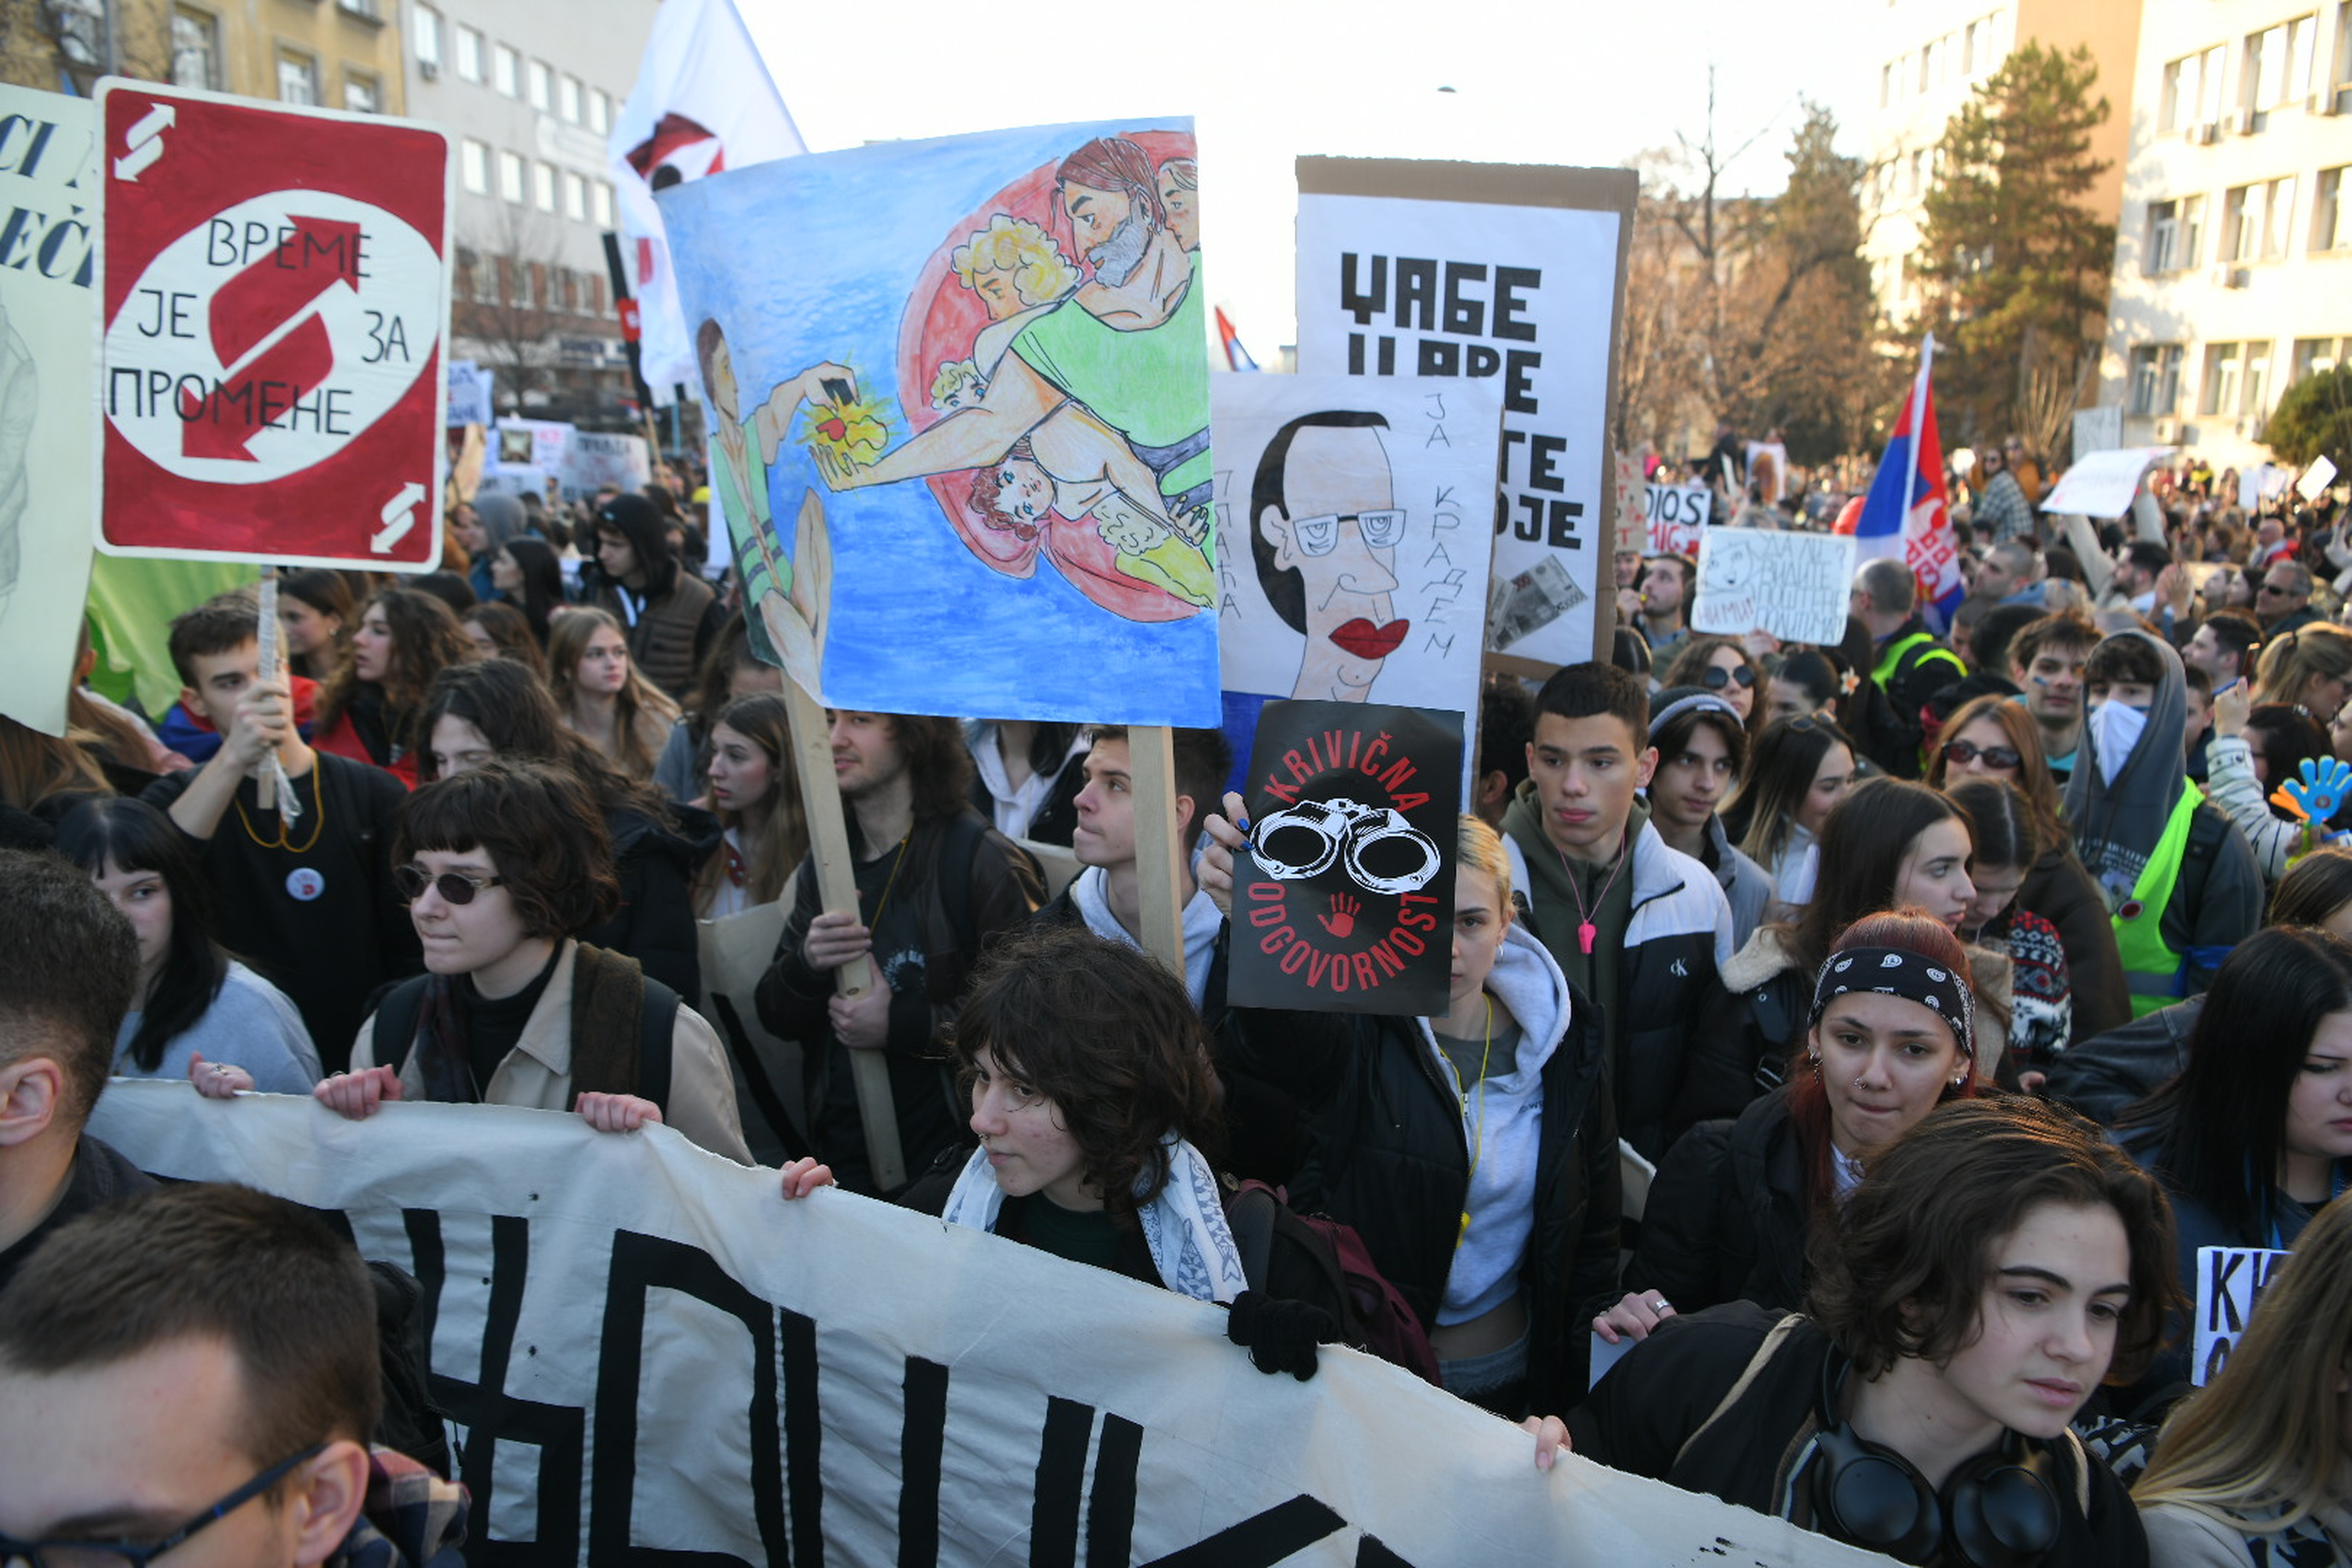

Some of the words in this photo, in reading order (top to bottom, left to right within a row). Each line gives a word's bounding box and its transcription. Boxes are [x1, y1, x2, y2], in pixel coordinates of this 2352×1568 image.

[208, 218, 372, 278] ВРЕМЕ
[138, 289, 197, 338] ЈЕ
[361, 310, 410, 363] ЗА
[109, 367, 353, 436] ПРОМЕНЕ
[1265, 730, 1431, 813] KRIVIČNA
[1249, 882, 1439, 992] ODGOVORNOST
